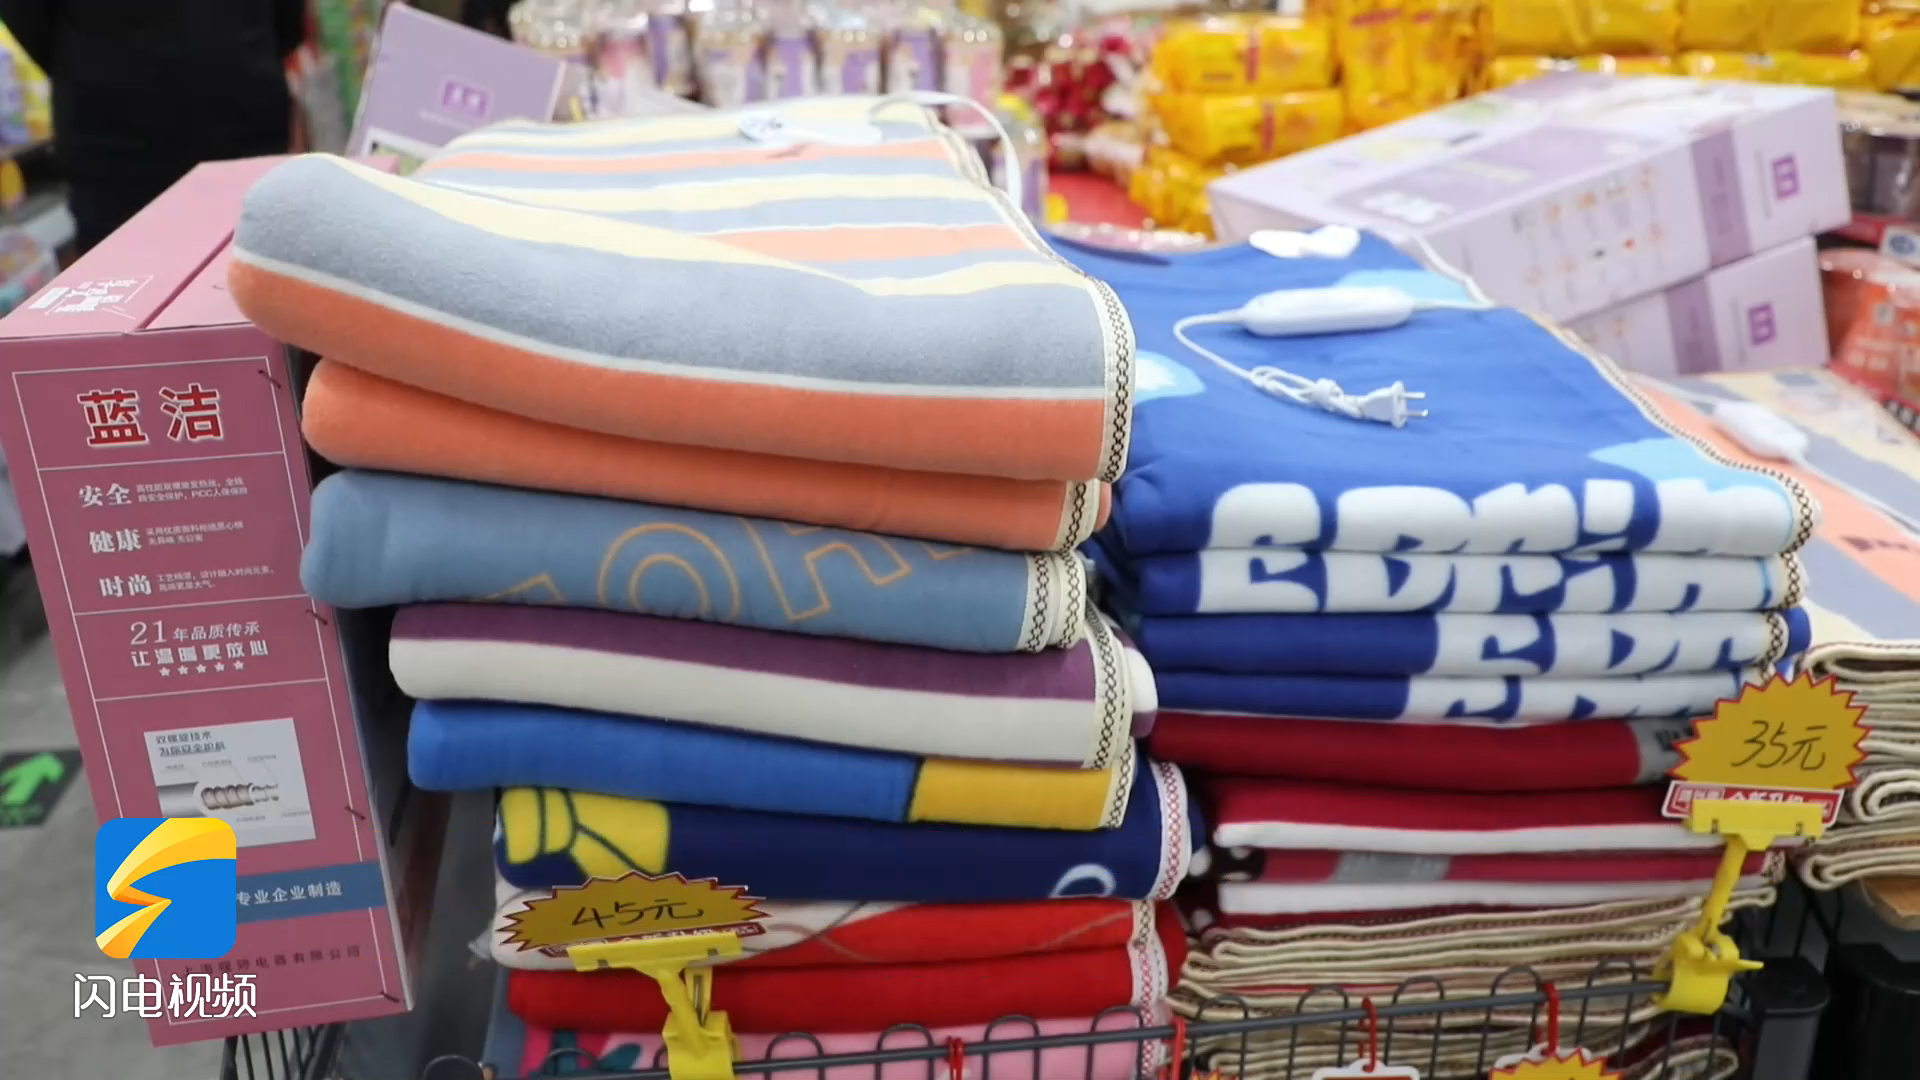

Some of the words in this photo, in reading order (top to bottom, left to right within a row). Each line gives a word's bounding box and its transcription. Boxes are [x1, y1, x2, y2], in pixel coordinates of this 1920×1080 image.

[77, 382, 224, 448] 蓝洁
[78, 483, 132, 508] 安全
[89, 528, 142, 553] 健康
[99, 573, 152, 597] 时尚
[130, 620, 260, 645] 21年品质传承
[131, 640, 268, 667] 让温暖更放心
[1731, 720, 1828, 771] 35元
[236, 881, 342, 906] 专业企业制造
[572, 899, 704, 929] 45元
